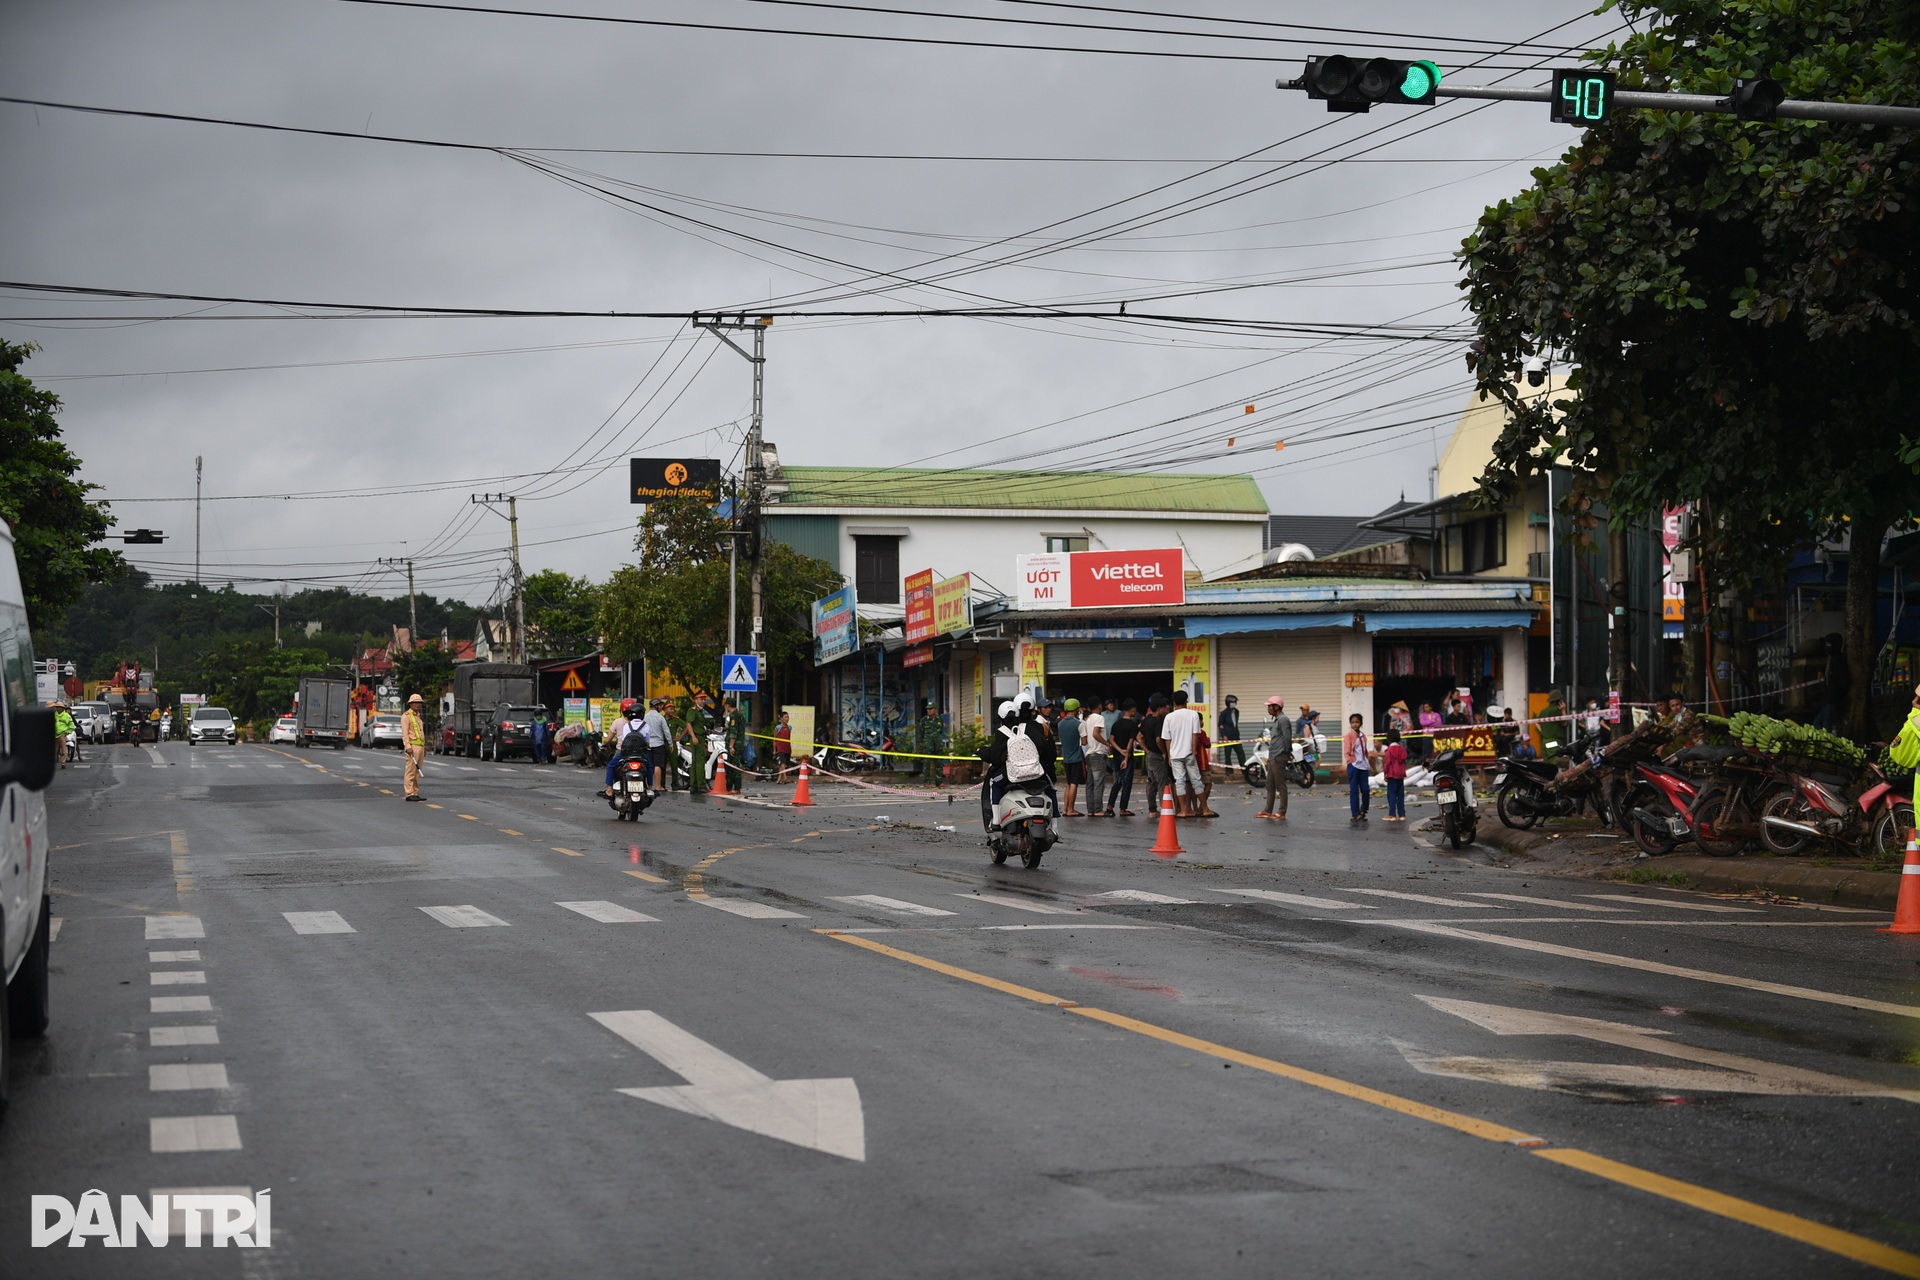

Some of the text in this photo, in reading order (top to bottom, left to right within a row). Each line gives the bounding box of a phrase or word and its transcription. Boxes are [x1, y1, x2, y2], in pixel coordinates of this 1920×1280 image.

[1562, 78, 1605, 120] 40
[1027, 567, 1061, 584] ƯỚT
[1090, 562, 1164, 580] viettel
[1034, 586, 1054, 599] MI
[1119, 583, 1164, 593] telecom
